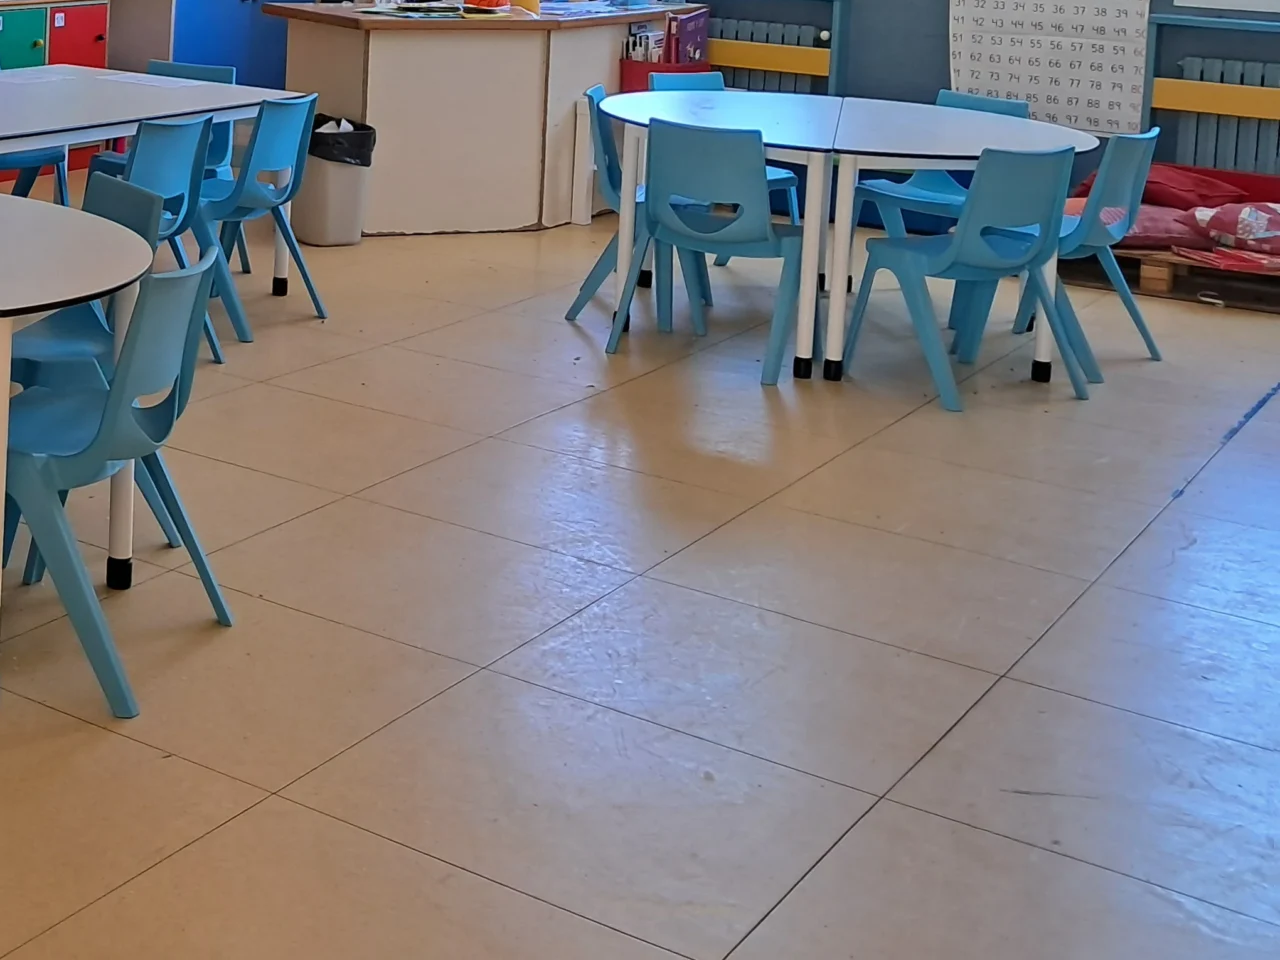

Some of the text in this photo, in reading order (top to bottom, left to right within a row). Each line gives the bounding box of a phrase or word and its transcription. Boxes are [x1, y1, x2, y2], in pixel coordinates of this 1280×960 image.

[993, 0, 1005, 10] 33
[1012, 1, 1025, 11] 34
[1032, 2, 1045, 13] 35
[1052, 4, 1065, 15] 36
[1073, 5, 1086, 16] 37
[1094, 6, 1107, 17] 38
[1115, 8, 1128, 19] 39
[953, 15, 1127, 37] 41 42 43 44 45 46 47 48 49
[952, 33, 1126, 56] 51 52 53 54 55 56 57 58 59
[970, 52, 1125, 74] 62 63 64 65 66 67 68 69
[969, 69, 1124, 93] 72 73 74 75 76 77 78 79
[1045, 94, 1122, 111] 86 87 88 89
[1044, 112, 1120, 130] 96 97 98 99
